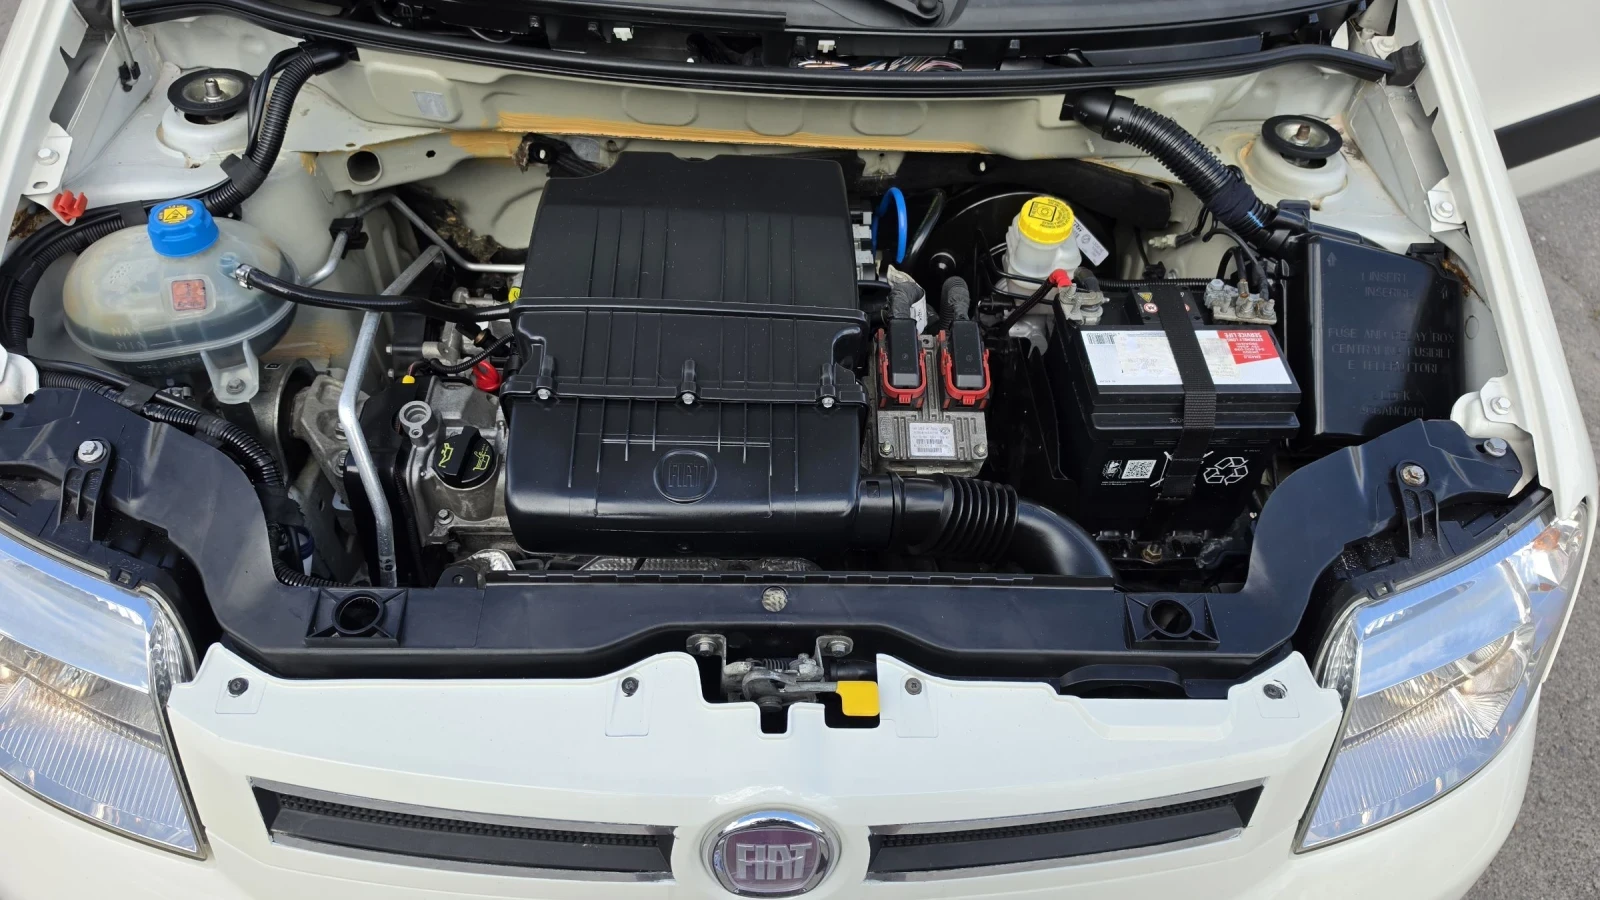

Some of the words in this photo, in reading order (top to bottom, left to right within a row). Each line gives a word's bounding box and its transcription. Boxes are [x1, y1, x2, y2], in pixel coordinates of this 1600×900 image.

[1369, 271, 1408, 284] INSERT
[1328, 327, 1358, 340] FUSE
[1363, 328, 1389, 341] AND
[1391, 329, 1427, 343] RELAY
[1432, 332, 1455, 344] BOX
[1407, 347, 1450, 360] FUSIBILI
[1347, 359, 1356, 371] E
[668, 462, 705, 488] FIAT
[735, 842, 812, 880] FIAT
